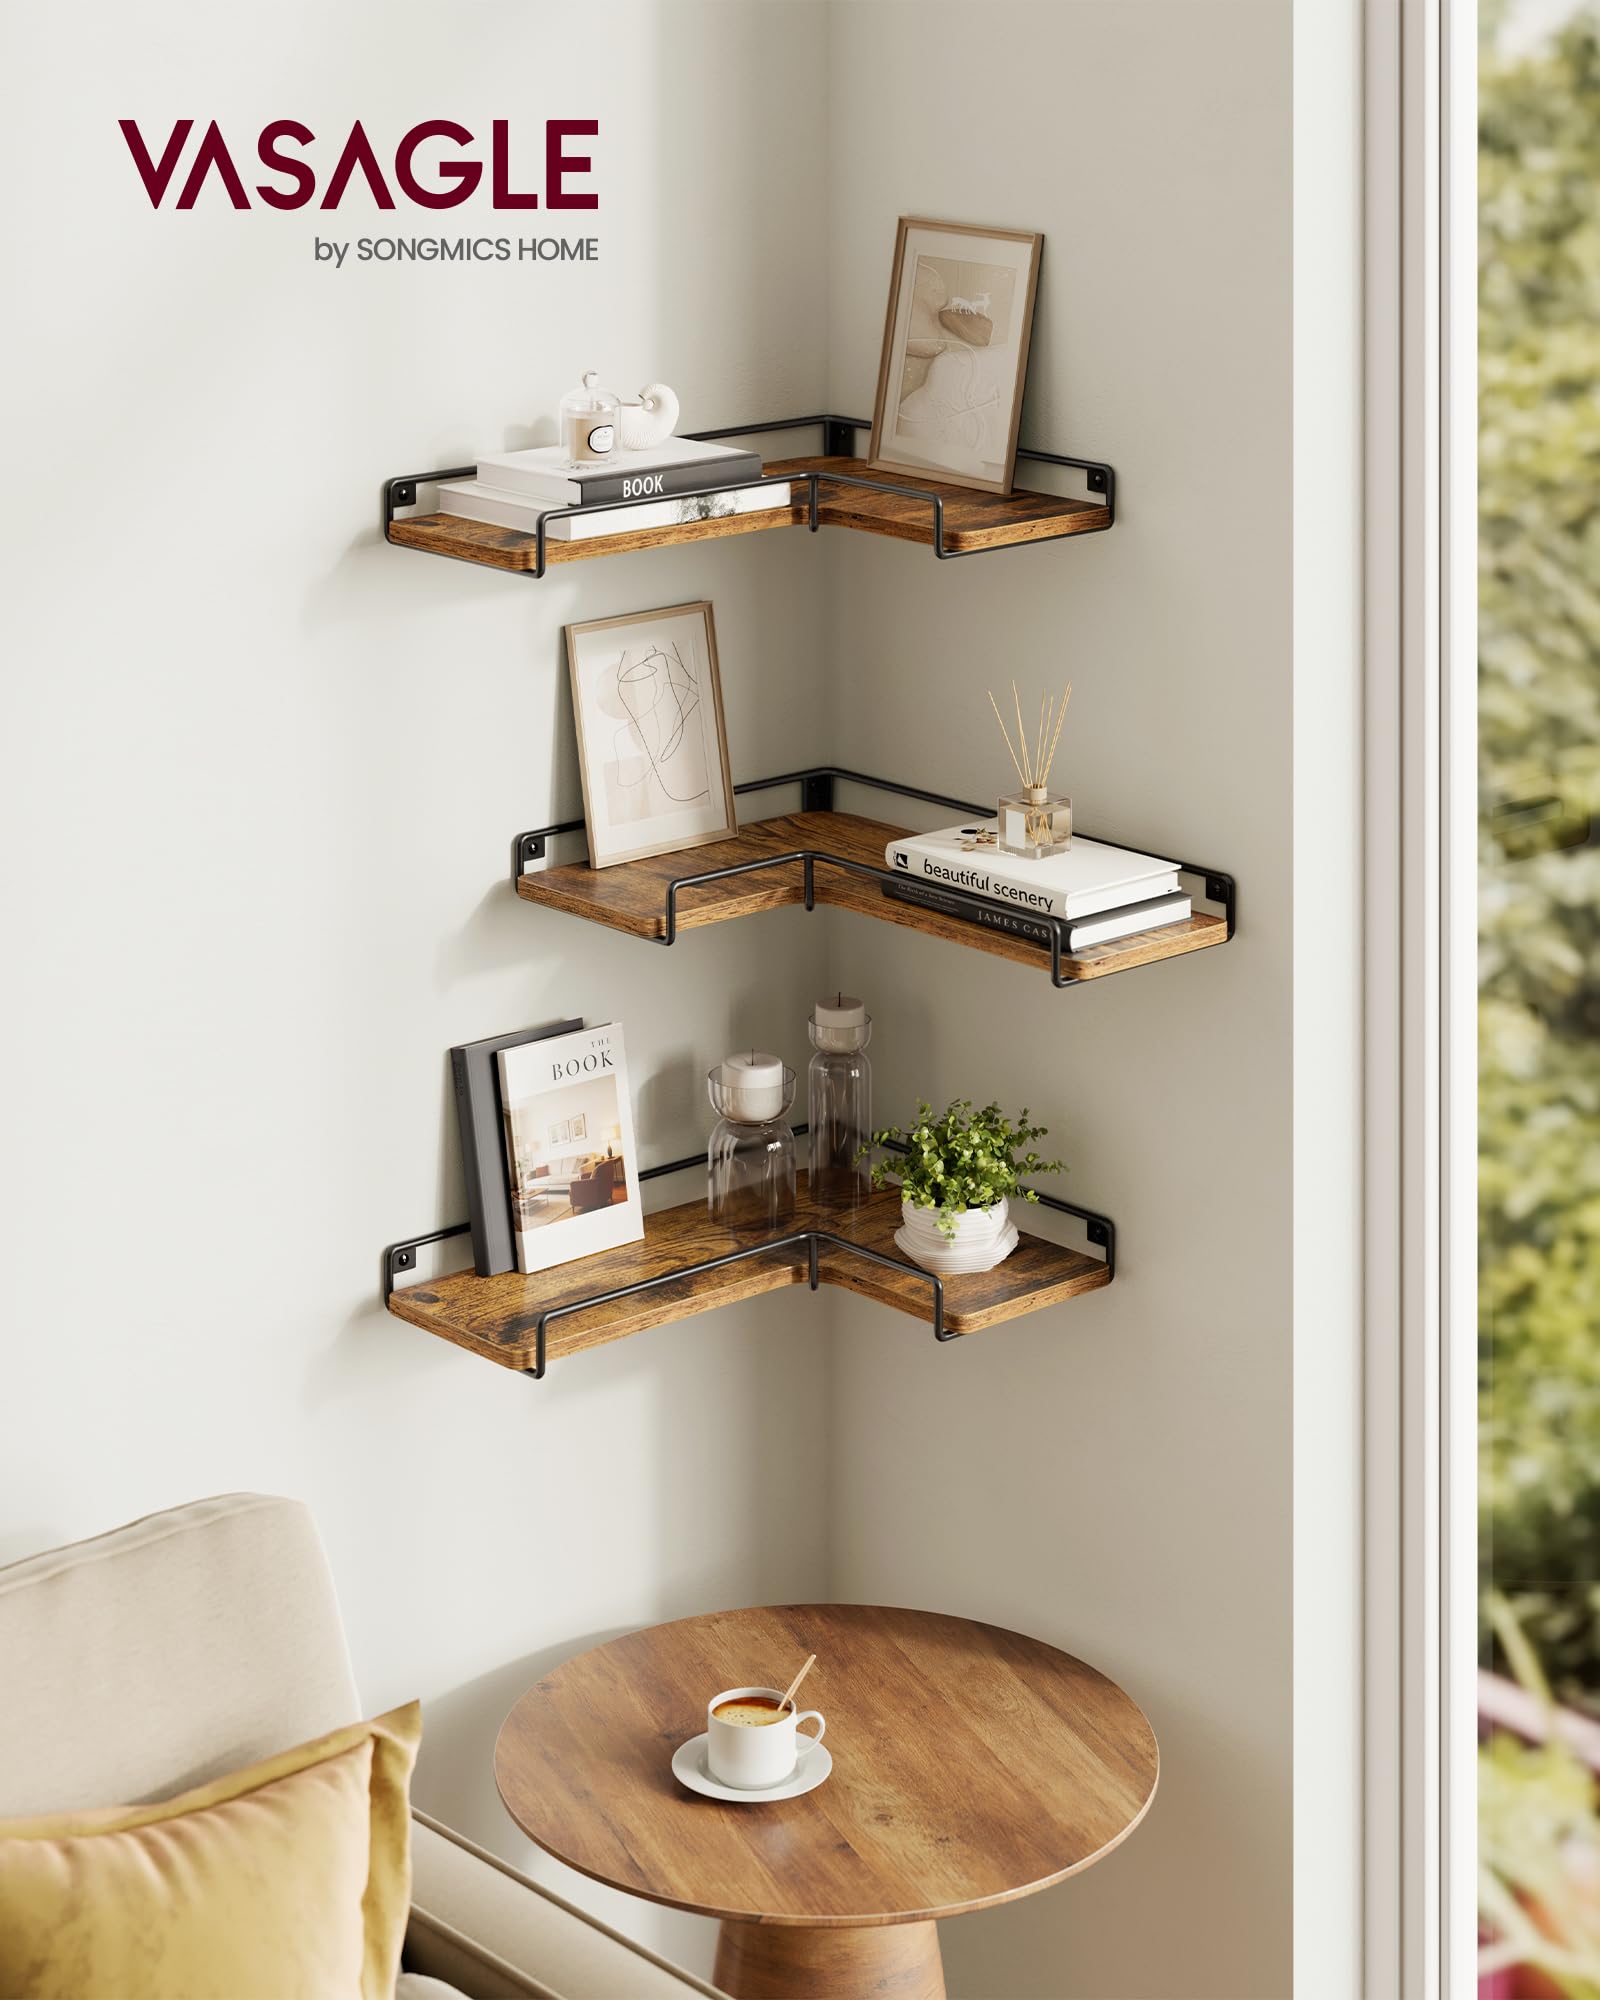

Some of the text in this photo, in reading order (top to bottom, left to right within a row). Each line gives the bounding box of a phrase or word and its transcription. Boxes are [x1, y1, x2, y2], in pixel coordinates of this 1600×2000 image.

[623, 474, 664, 498] BOOK
[923, 858, 990, 891] beautiful
[993, 882, 1054, 913] scenery
[977, 910, 1019, 929] JAMES
[591, 1037, 610, 1048] THE
[552, 1049, 613, 1080] BOOK
